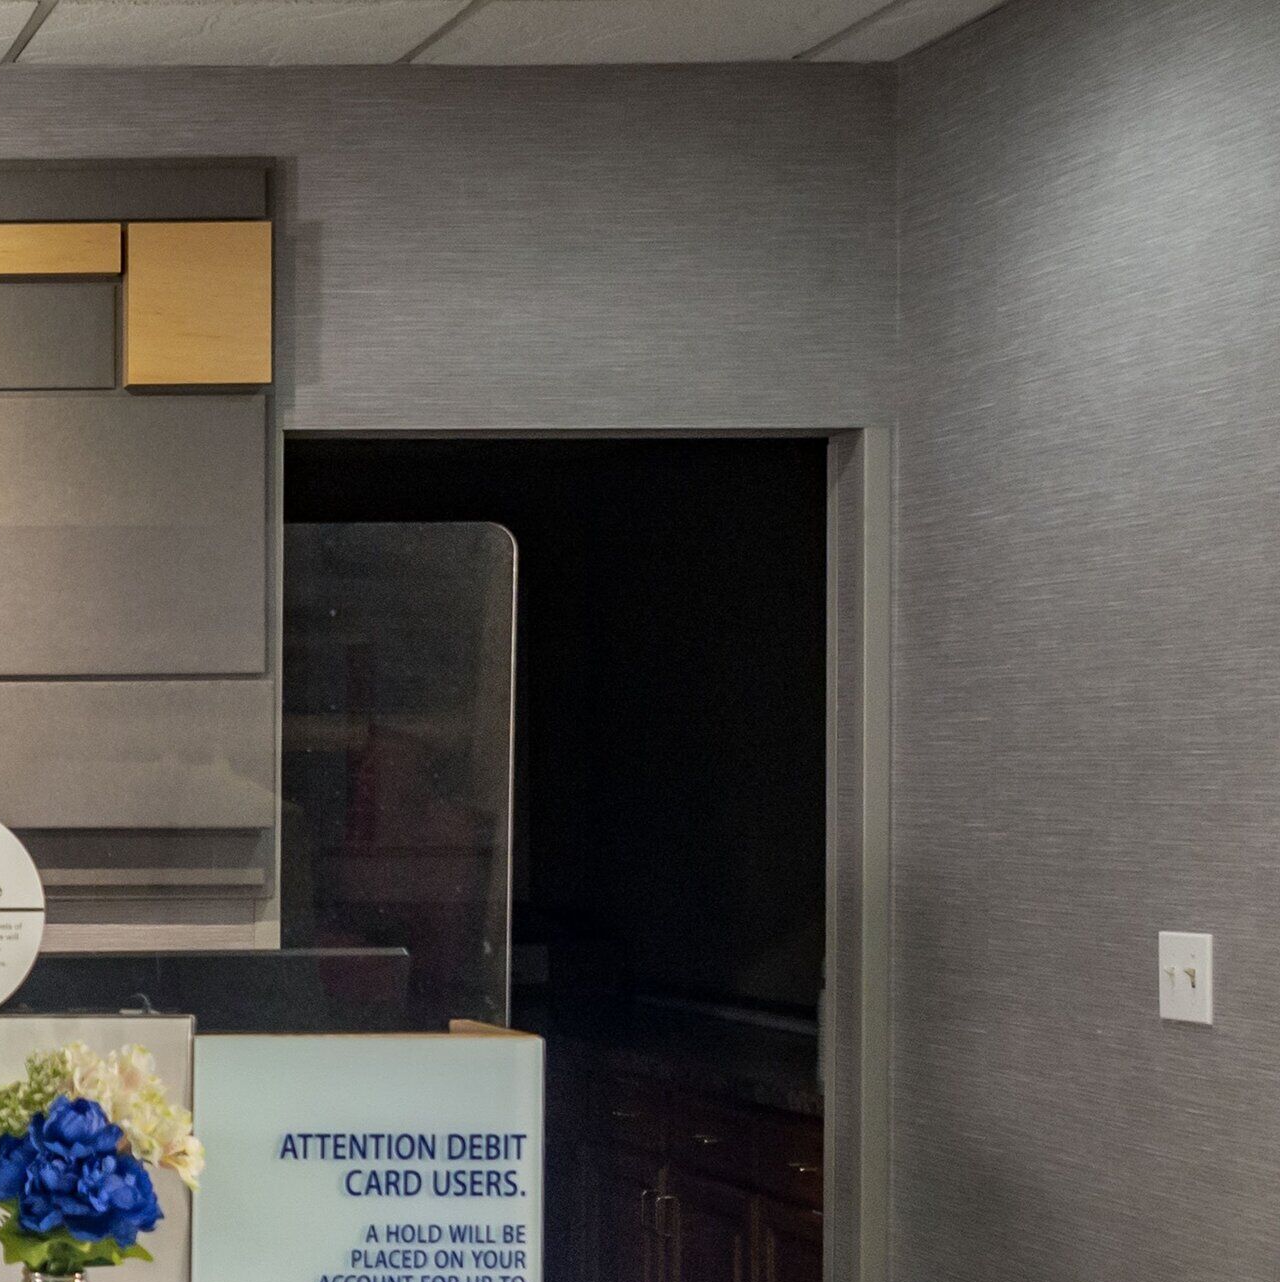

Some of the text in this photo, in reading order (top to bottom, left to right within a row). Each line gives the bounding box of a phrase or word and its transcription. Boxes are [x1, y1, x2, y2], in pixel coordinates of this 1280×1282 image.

[280, 1133, 527, 1160] ATTENTION DEBIT
[345, 1170, 527, 1196] CARD USERS.
[366, 1224, 526, 1243] A HOLD WILL BE
[351, 1250, 526, 1269] PLACED ON YOUR
